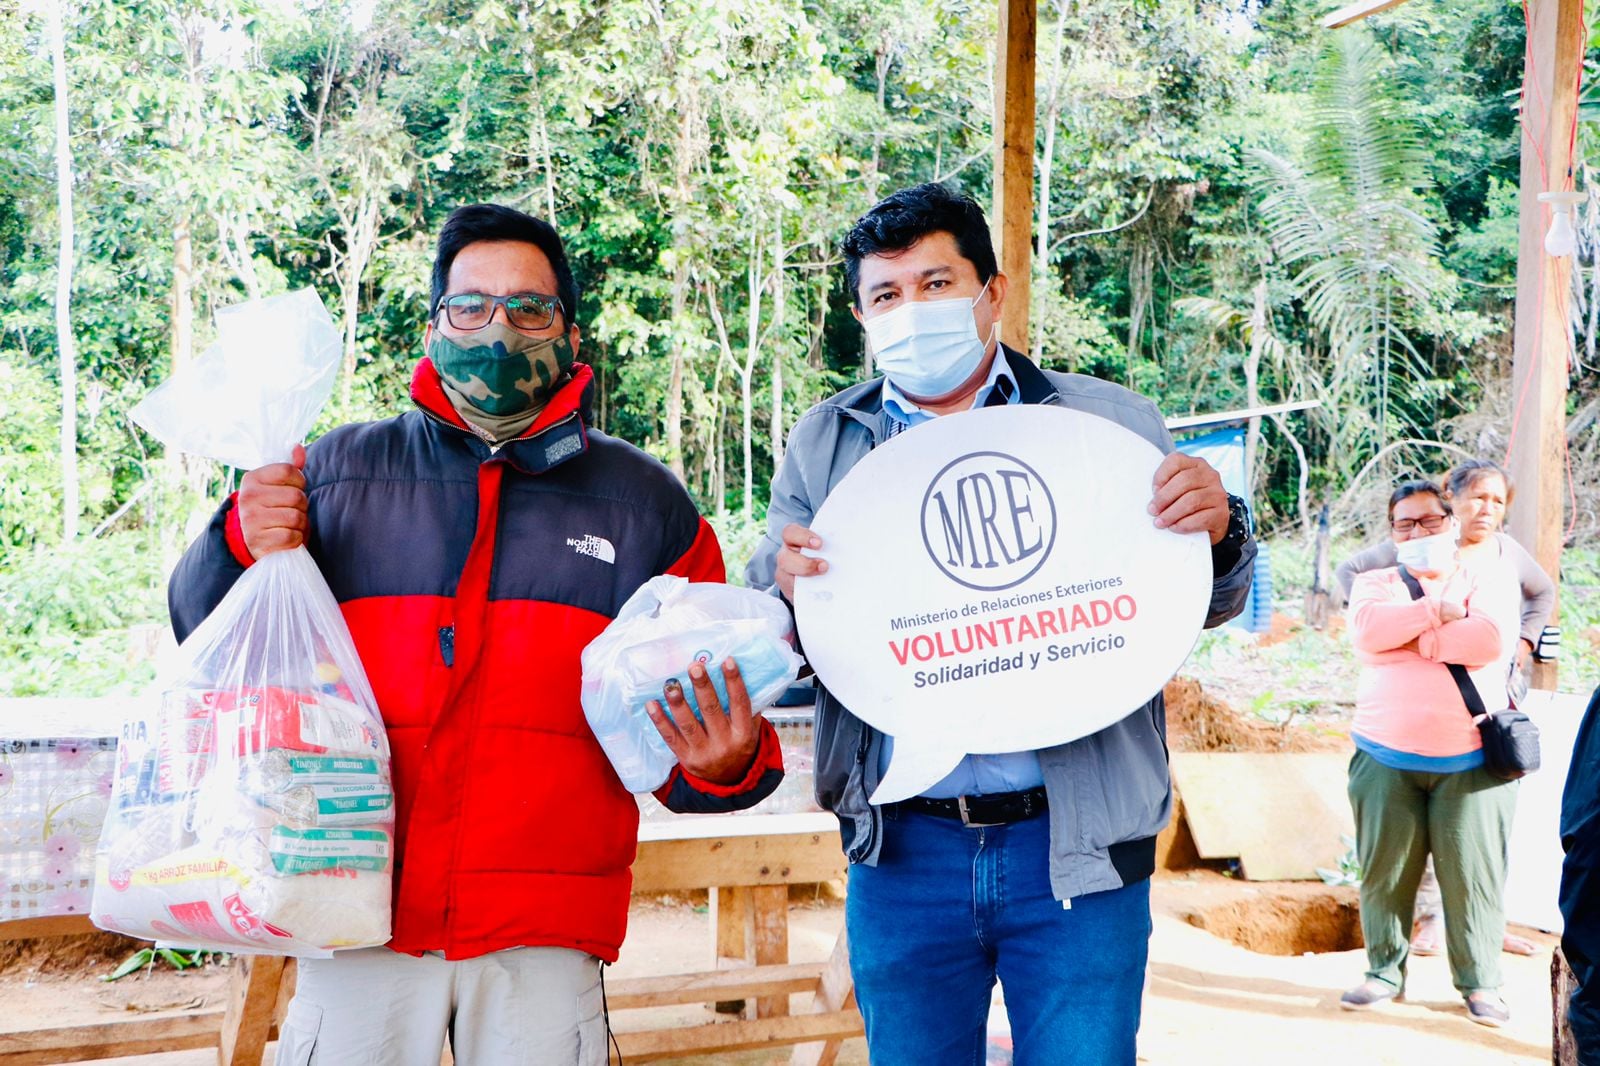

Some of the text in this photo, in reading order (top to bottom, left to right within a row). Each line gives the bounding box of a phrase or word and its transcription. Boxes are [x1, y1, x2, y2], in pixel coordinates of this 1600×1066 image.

[932, 469, 1043, 569] MRE
[566, 538, 601, 551] NORTH
[576, 546, 600, 558] FACE
[584, 534, 601, 545] THE
[890, 576, 1123, 631] Ministerio de Relaciones Exteriores
[888, 594, 1137, 666] VOLUNTARIADO
[913, 633, 1125, 688] Solidaridad y Servicio
[159, 865, 187, 879] ARROZ
